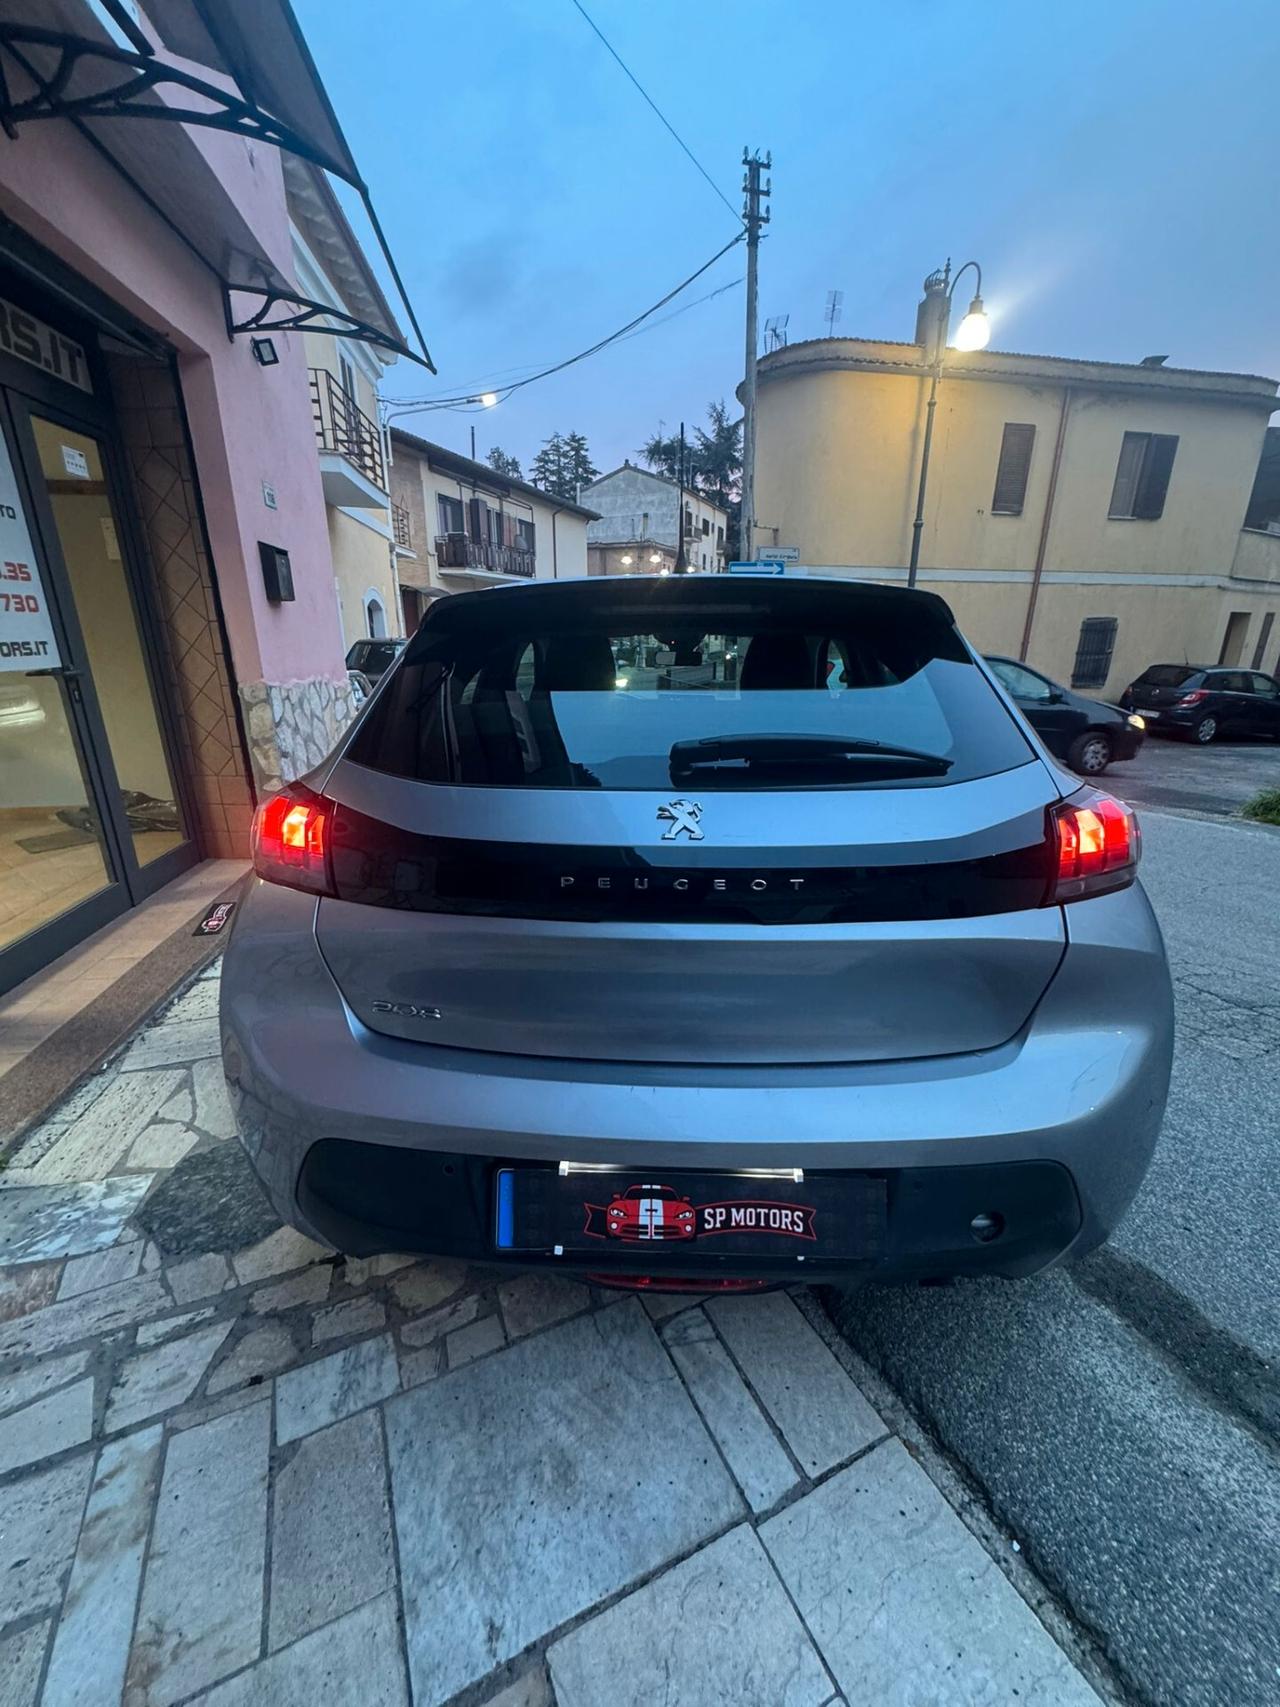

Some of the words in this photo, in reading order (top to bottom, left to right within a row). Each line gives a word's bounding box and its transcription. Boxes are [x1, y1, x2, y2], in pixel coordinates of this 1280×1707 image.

[560, 876, 804, 890] PEUGEOT
[372, 1001, 441, 1018] 208
[704, 1208, 726, 1229] SP
[731, 1208, 804, 1232] MOTORS
